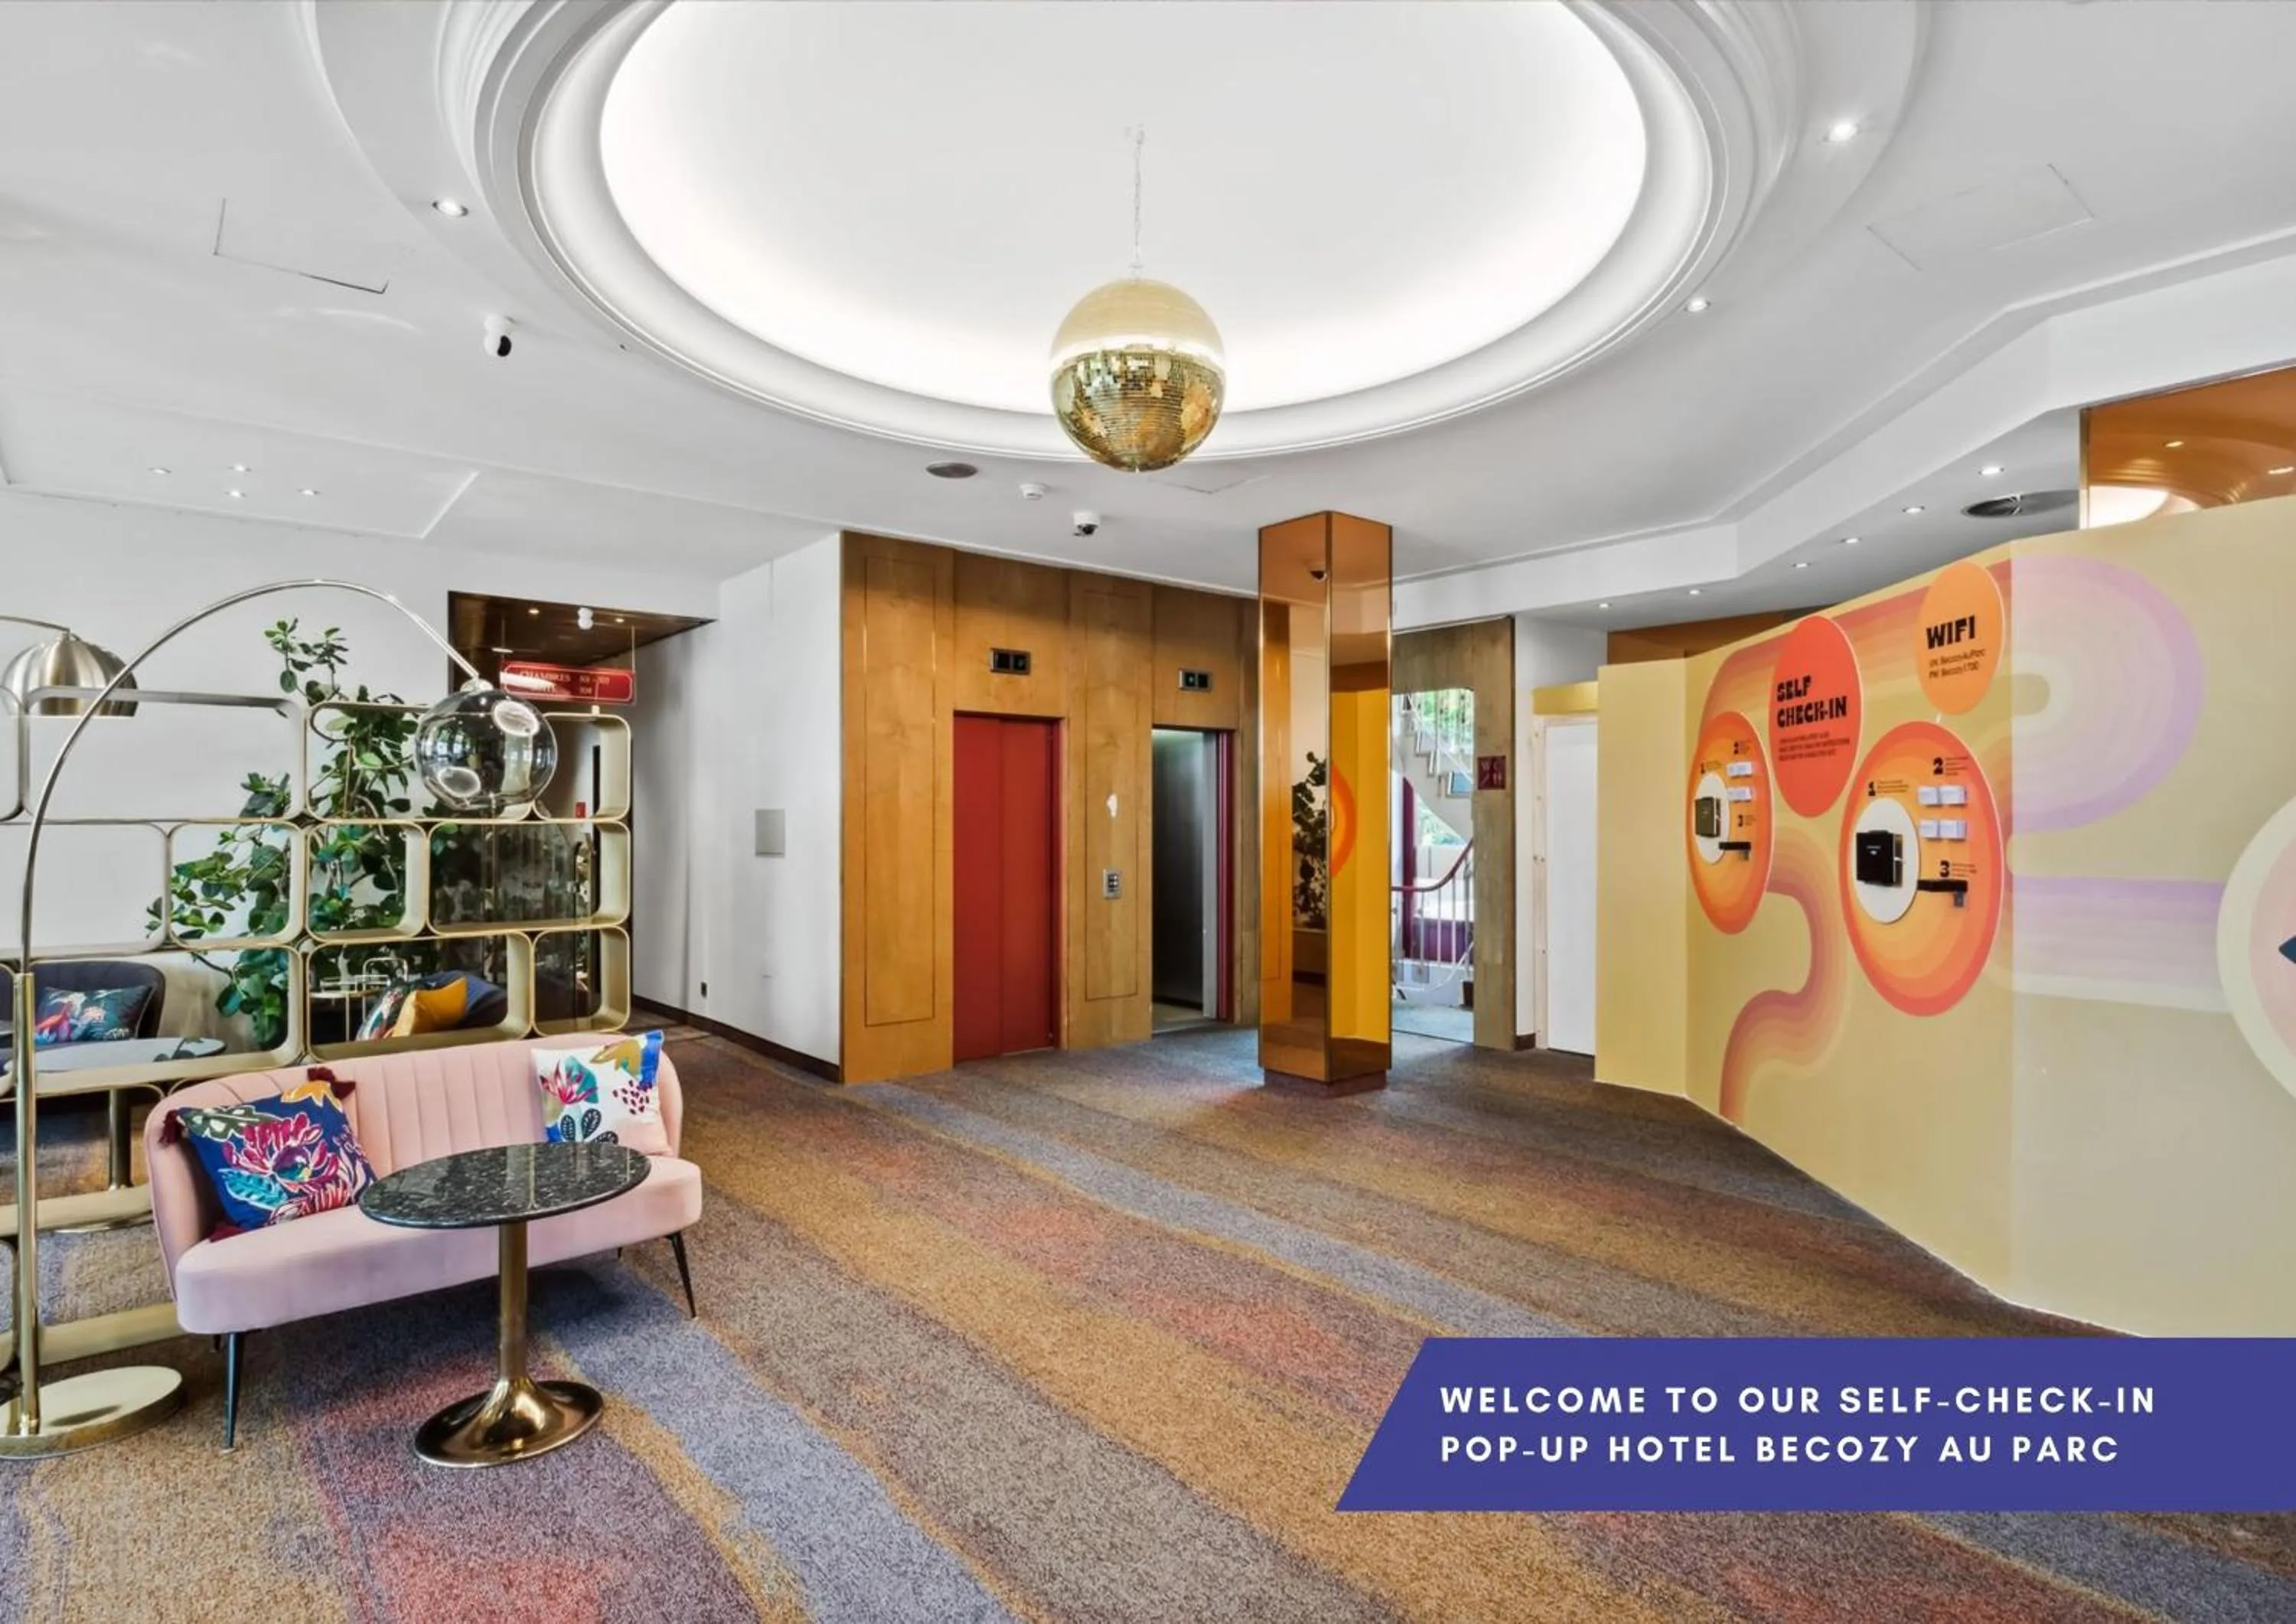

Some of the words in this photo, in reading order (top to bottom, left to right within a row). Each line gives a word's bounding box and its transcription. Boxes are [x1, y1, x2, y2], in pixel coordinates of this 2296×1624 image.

[1926, 615, 1975, 650] WIFI
[1776, 674, 1811, 703] SELF
[1776, 695, 1848, 729] CHECK-IN
[1933, 757, 1943, 775] 2
[1867, 781, 1876, 797] 1
[1939, 859, 1949, 878] 3
